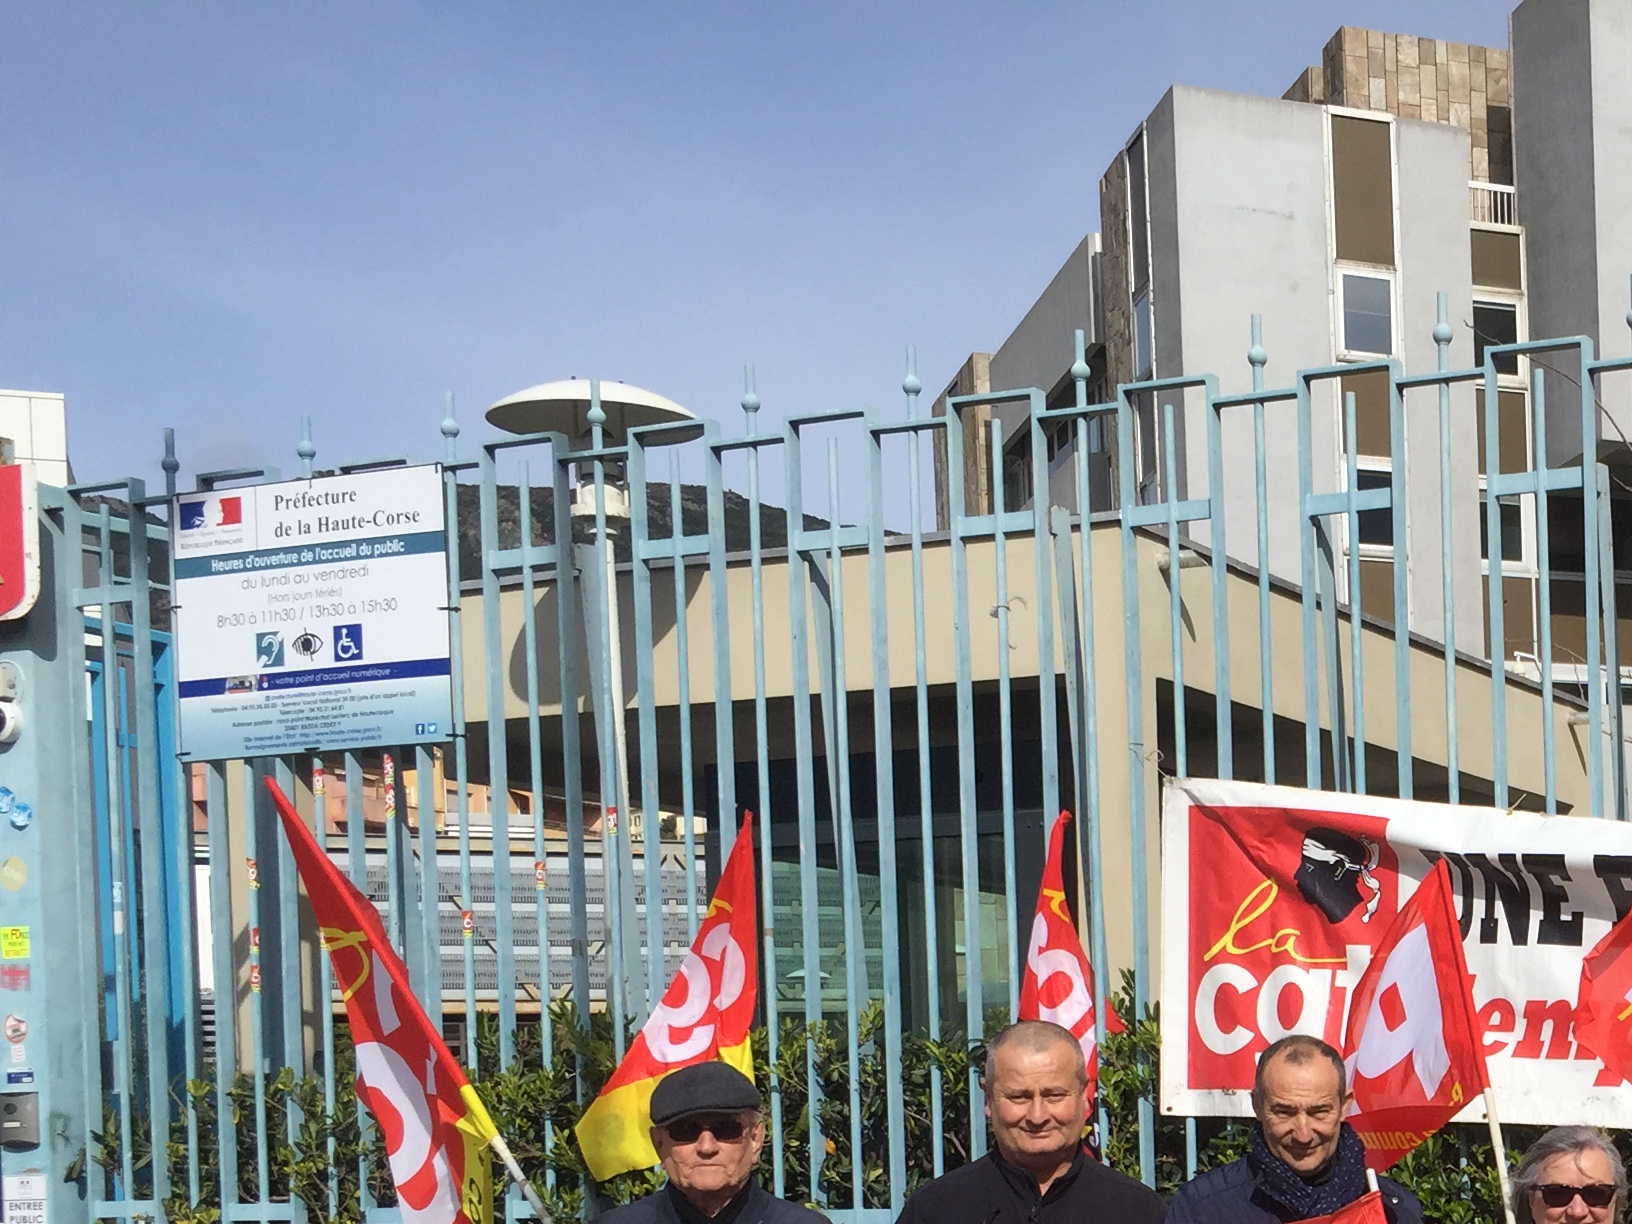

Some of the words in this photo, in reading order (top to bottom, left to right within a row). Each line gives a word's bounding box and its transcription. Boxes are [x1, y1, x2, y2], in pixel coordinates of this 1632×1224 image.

[274, 490, 357, 511] Préfecture
[274, 522, 292, 538] de
[298, 519, 311, 536] la
[317, 509, 420, 533] Haute-Corse
[211, 558, 243, 572] Heures
[245, 551, 298, 569] d'ouverture
[301, 549, 313, 562] de
[315, 543, 357, 560] l'accueil
[358, 542, 372, 556] du
[374, 539, 405, 557] public
[241, 577, 257, 590] du
[261, 572, 290, 588] lundi
[293, 573, 310, 585] au
[313, 564, 369, 581] vendredi
[217, 612, 245, 628] 8h30
[248, 611, 257, 625] à
[261, 607, 296, 624] 11h30
[309, 602, 345, 619] 13h30
[348, 600, 357, 615] à
[361, 597, 398, 613] 15h30
[1203, 878, 1374, 963] la
[9, 1201, 44, 1212] ENTREE
[9, 1214, 44, 1224] PUBLIC
